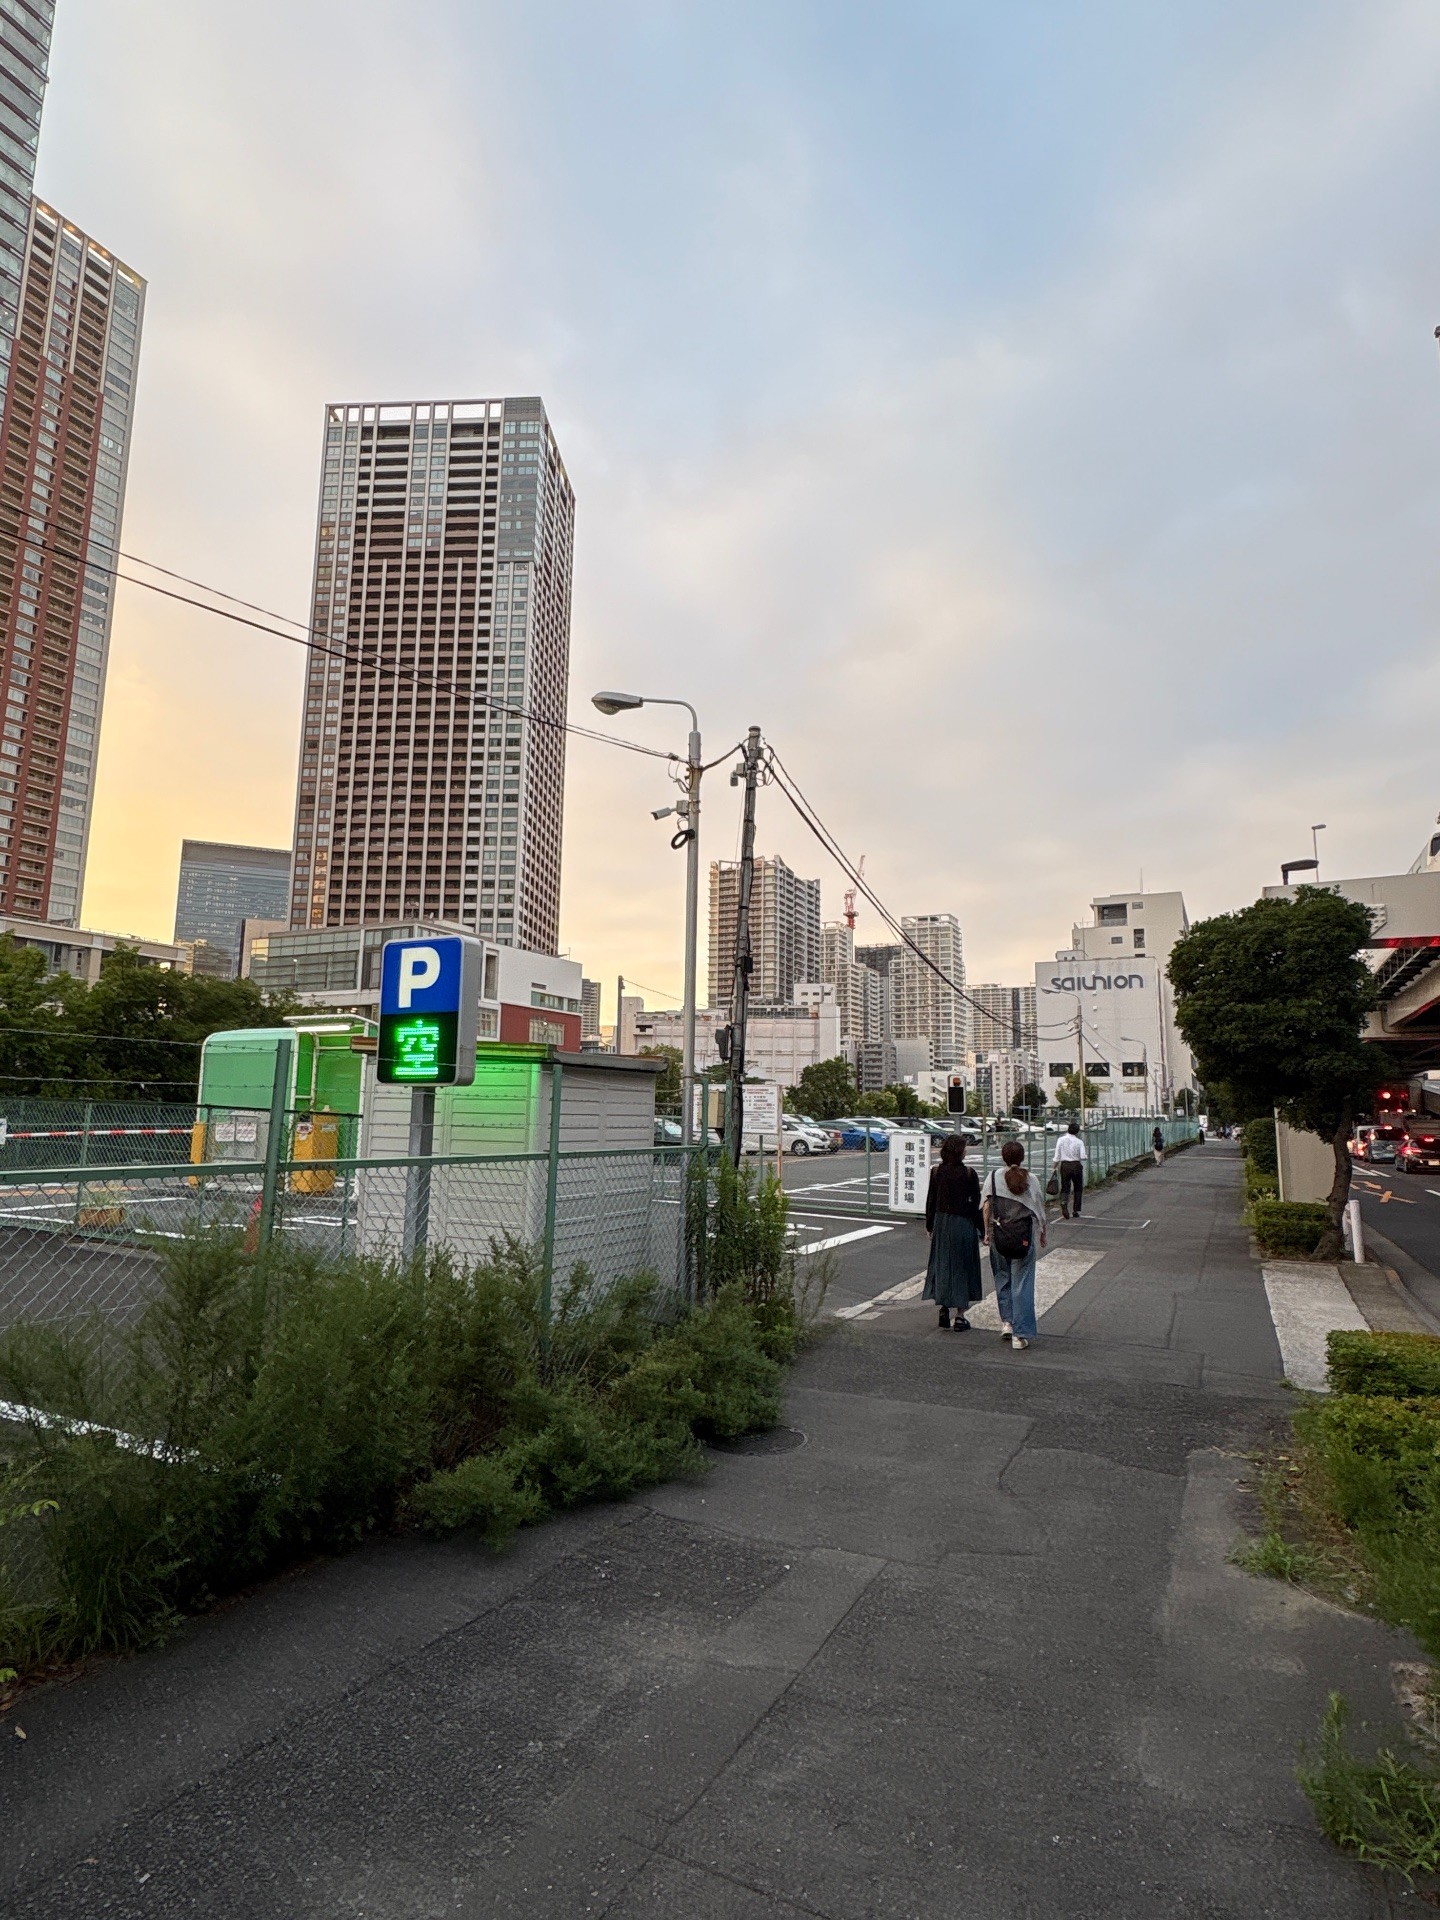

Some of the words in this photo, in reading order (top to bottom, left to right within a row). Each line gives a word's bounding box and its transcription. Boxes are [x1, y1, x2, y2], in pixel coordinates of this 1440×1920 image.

[398, 946, 441, 1009] P
[395, 1019, 440, 1076] 空
[904, 1142, 915, 1204] 車両整理場
